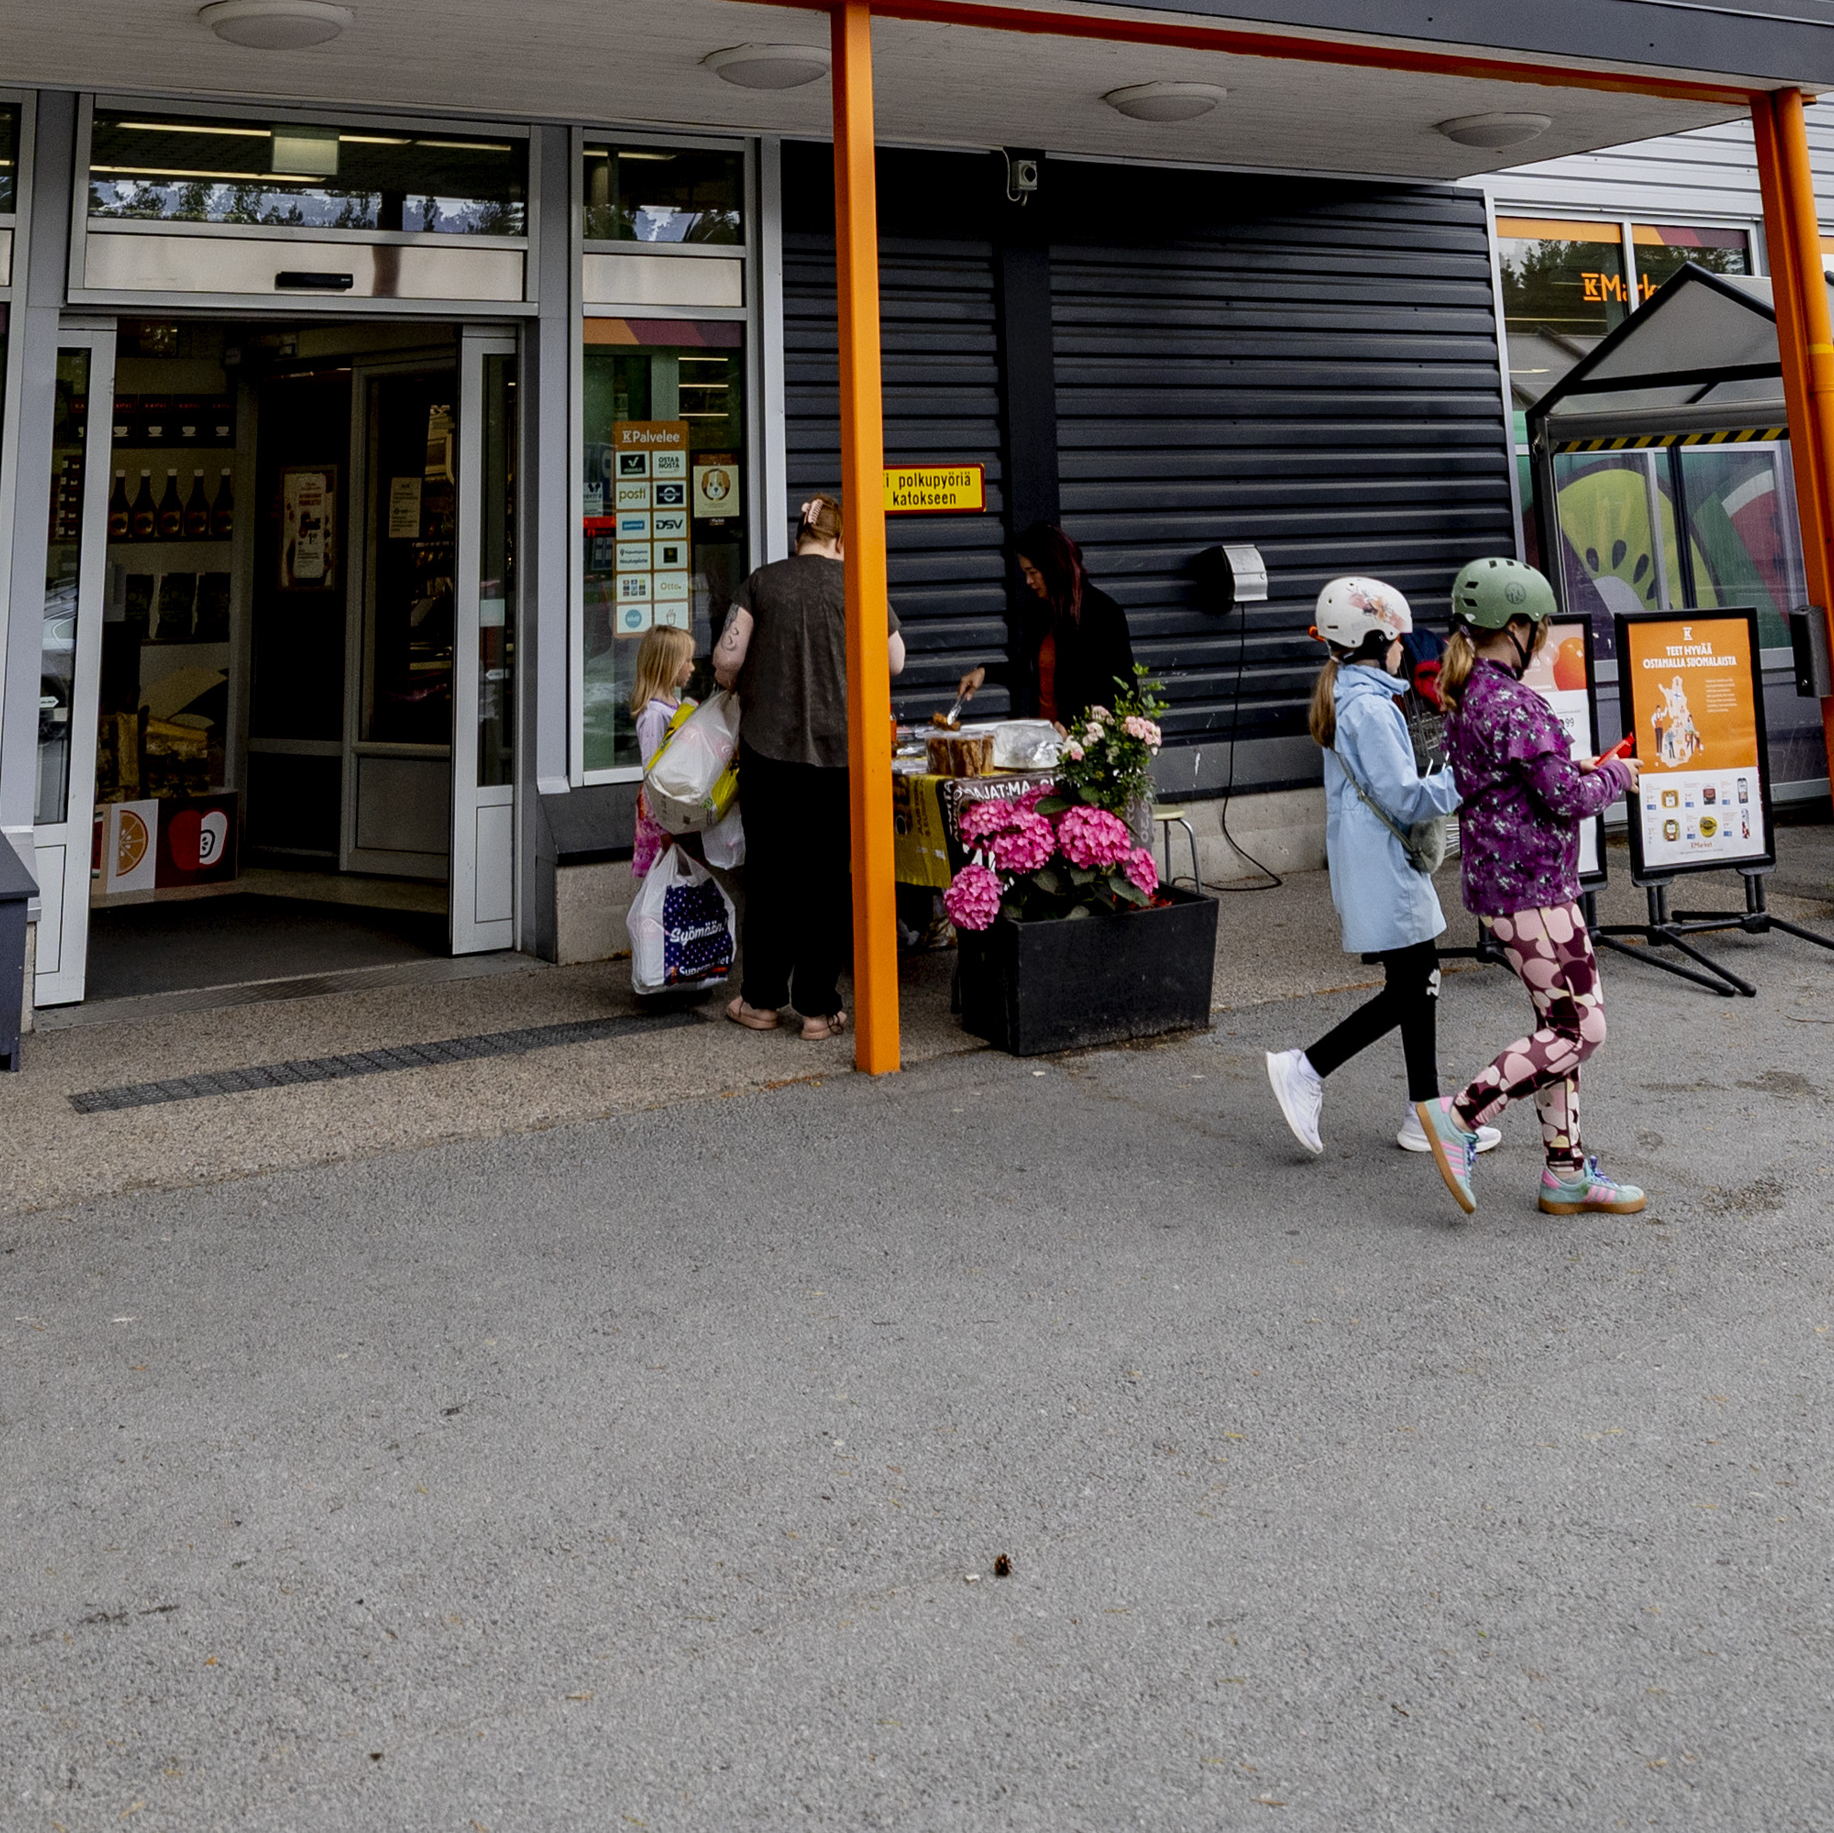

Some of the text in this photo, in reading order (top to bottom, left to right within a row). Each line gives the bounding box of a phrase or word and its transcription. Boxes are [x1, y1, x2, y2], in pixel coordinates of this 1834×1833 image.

[632, 430, 680, 444] Palvelee
[898, 471, 971, 490] polkupyöriä
[619, 488, 646, 502] posti
[893, 491, 957, 506] katokseen
[656, 519, 683, 531] DSV
[1666, 642, 1713, 656] TEET HYVÄÄ
[1642, 656, 1737, 669] OSTAMALLA SUOMALAISTA
